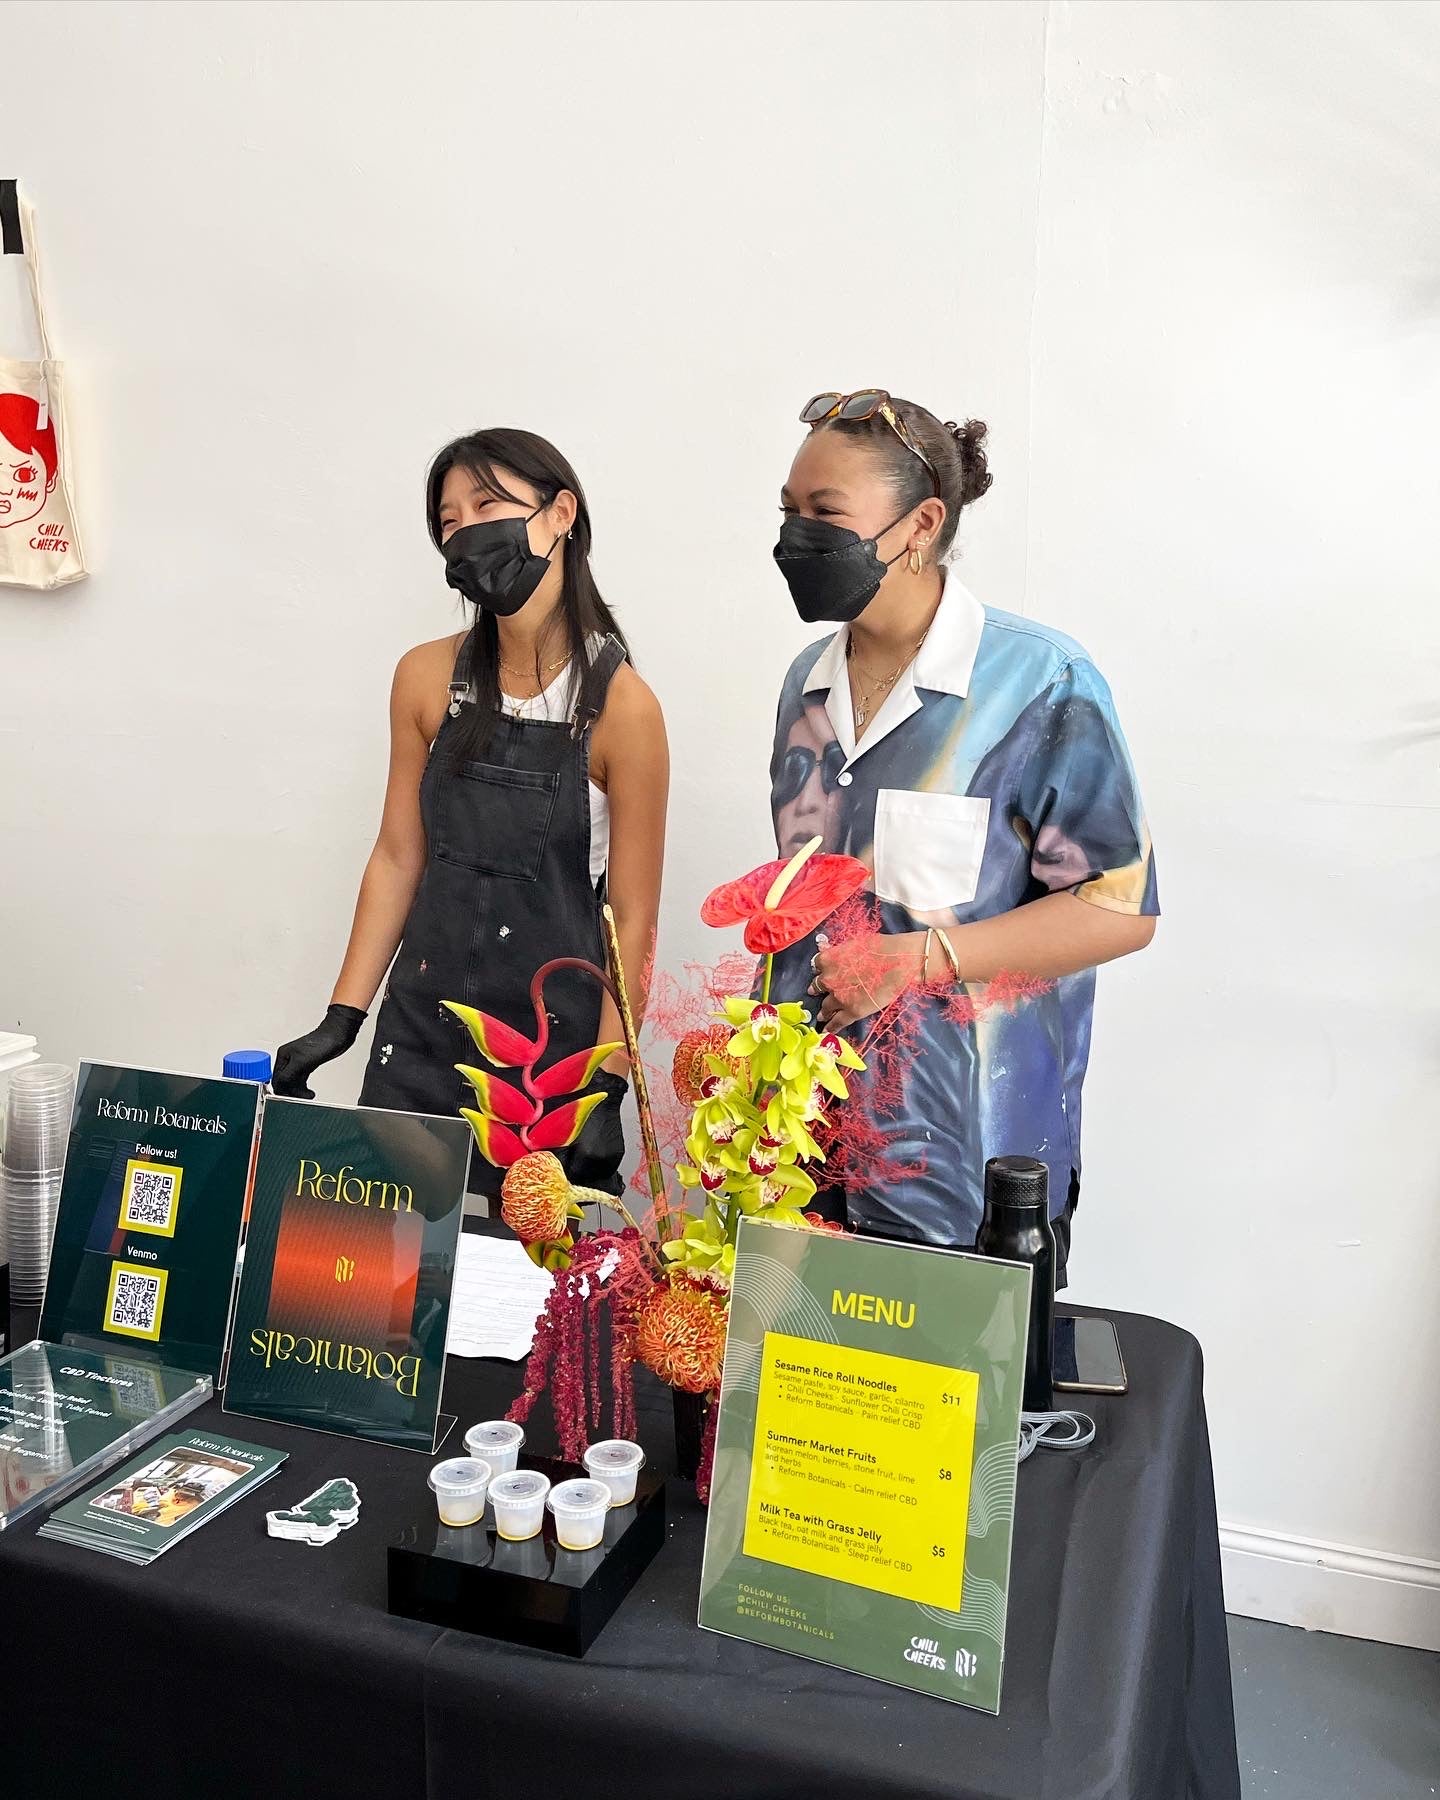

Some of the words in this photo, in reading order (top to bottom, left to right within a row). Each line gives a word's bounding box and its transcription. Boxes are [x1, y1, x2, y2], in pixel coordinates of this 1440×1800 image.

[29, 538, 69, 552] CHEEKS
[38, 524, 64, 536] CHILI
[97, 1098, 149, 1124] Reform
[154, 1106, 227, 1135] Botanicals
[135, 1143, 163, 1157] Follow
[165, 1149, 178, 1159] us!
[296, 1159, 414, 1213] Reform
[127, 1245, 158, 1260] Venmo
[831, 1288, 916, 1329] MENU
[60, 1366, 85, 1376] CBD
[83, 1371, 134, 1388] Tinctures
[250, 1328, 422, 1397] Botanicals
[775, 1359, 811, 1374] Sesame
[813, 1367, 833, 1380] Rice
[836, 1372, 855, 1384] Roll
[857, 1377, 897, 1393] Noodles
[773, 1371, 802, 1384] Sesame
[804, 1377, 825, 1389] paste,
[828, 1384, 840, 1393] soy
[843, 1386, 867, 1398] sauce,
[895, 1396, 925, 1410] cilantro
[787, 1383, 803, 1394] Chili
[806, 1387, 834, 1401] Cheeks
[841, 1395, 879, 1410] Sunflower
[882, 1403, 899, 1416] Chili
[902, 1408, 922, 1421] Crisp
[941, 1392, 961, 1406] $11
[786, 1394, 813, 1407] Reform
[815, 1400, 854, 1416] Botanicals
[862, 1410, 878, 1421] Pain
[880, 1415, 901, 1426] relief
[903, 1418, 920, 1430] CBD
[765, 1453, 778, 1462] and
[781, 1456, 801, 1468] herbs
[766, 1443, 793, 1455] Korean
[795, 1450, 820, 1463] melon,
[823, 1456, 851, 1470] berries,
[853, 1464, 875, 1475] stone
[877, 1467, 896, 1481] fruit,
[898, 1472, 915, 1484] lime
[767, 1430, 807, 1447] Summer
[809, 1439, 844, 1457] Market
[847, 1448, 877, 1464] Fruits
[778, 1465, 806, 1479] Reform
[808, 1472, 846, 1489] Botanicals
[854, 1484, 874, 1496] Calm
[876, 1488, 896, 1500] relief
[899, 1494, 917, 1506] CBD
[938, 1468, 952, 1481] $8
[758, 1514, 779, 1527] Black
[781, 1521, 795, 1531] tea,
[797, 1526, 809, 1534] oat
[811, 1527, 826, 1540] milk
[828, 1532, 843, 1543] and
[845, 1538, 865, 1549] grass
[867, 1542, 883, 1555] jelly
[760, 1502, 781, 1516] Milk
[783, 1508, 801, 1521] Tea
[803, 1512, 824, 1527] with
[826, 1519, 854, 1535] Grass
[857, 1527, 882, 1543] Jelly
[772, 1528, 800, 1542] Reform
[802, 1535, 840, 1553] Botanicals
[847, 1548, 869, 1562] Sleep
[871, 1555, 891, 1567] relief
[894, 1560, 912, 1572] CBD
[932, 1545, 946, 1558] $5
[738, 1583, 774, 1599] FOLLOW
[736, 1606, 834, 1640] @REFORMBOTANICALS
[904, 1649, 946, 1670] CHEEKS
[911, 1636, 938, 1653] CHILI
